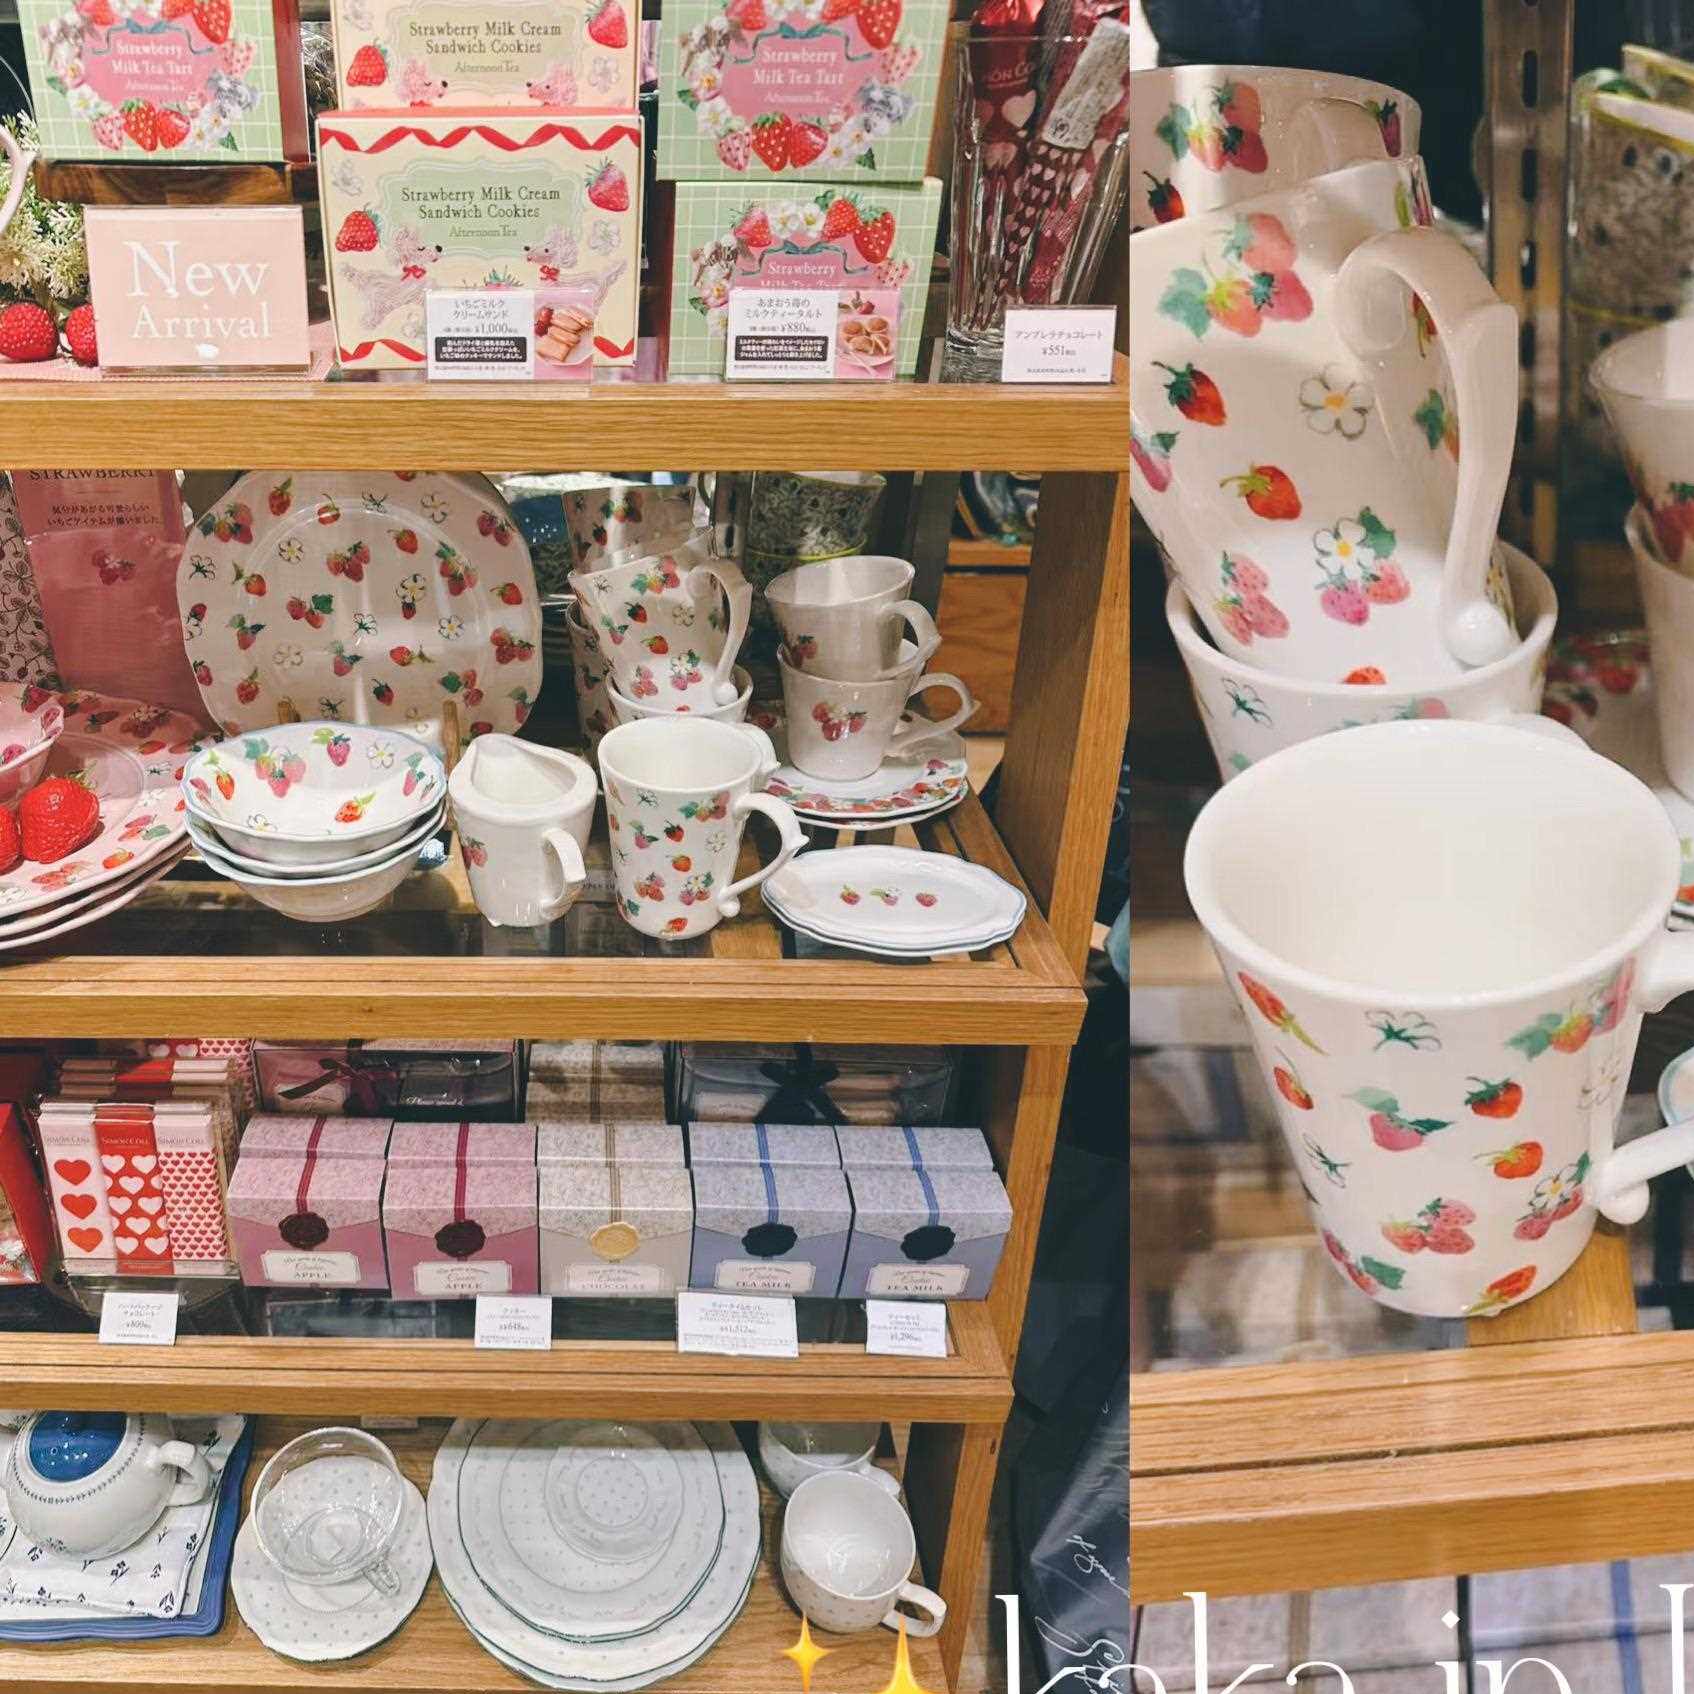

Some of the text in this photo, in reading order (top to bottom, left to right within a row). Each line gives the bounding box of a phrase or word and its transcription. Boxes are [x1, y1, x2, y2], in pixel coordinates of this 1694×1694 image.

[409, 21, 561, 41] Strawberry Milk Cream
[115, 42, 182, 59] Strawberry
[426, 38, 542, 54] Sandwich Cookies
[763, 47, 838, 66] Strawberry
[112, 59, 193, 75] Milk Tea Tart
[752, 68, 844, 84] Milk Tea Tart
[401, 186, 560, 204] Strawberry Milk Cream
[419, 204, 540, 219] Sandwich Cookies
[449, 225, 499, 238] Afternoon
[123, 240, 272, 299] New
[767, 262, 837, 277] Strawberry
[131, 302, 273, 339] Arrival
